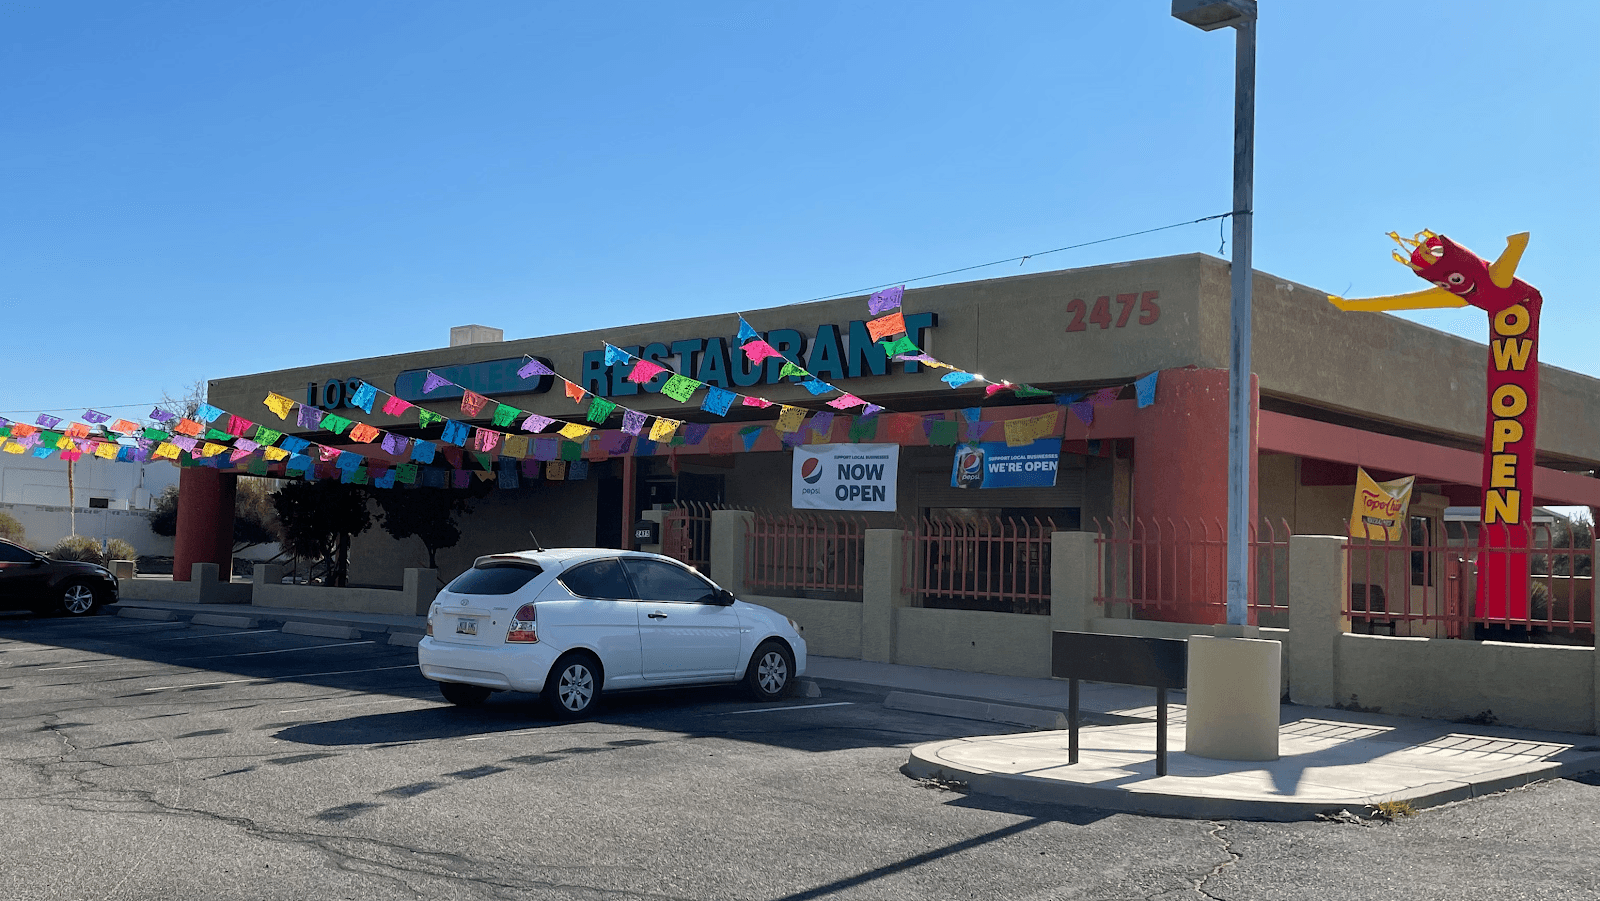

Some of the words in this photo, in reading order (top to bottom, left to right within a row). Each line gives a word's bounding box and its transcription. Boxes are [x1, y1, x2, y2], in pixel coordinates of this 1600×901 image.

[1065, 290, 1161, 333] 2475
[307, 377, 362, 411] LOS
[582, 312, 939, 398] RESTAURANT
[1484, 383, 1529, 525] OPEN
[837, 463, 885, 481] NOW
[988, 462, 1022, 473] WE'RE
[1024, 460, 1058, 472] OPEN
[802, 487, 821, 495] pepsi
[835, 484, 886, 502] OPEN
[1362, 490, 1386, 512] Topo
